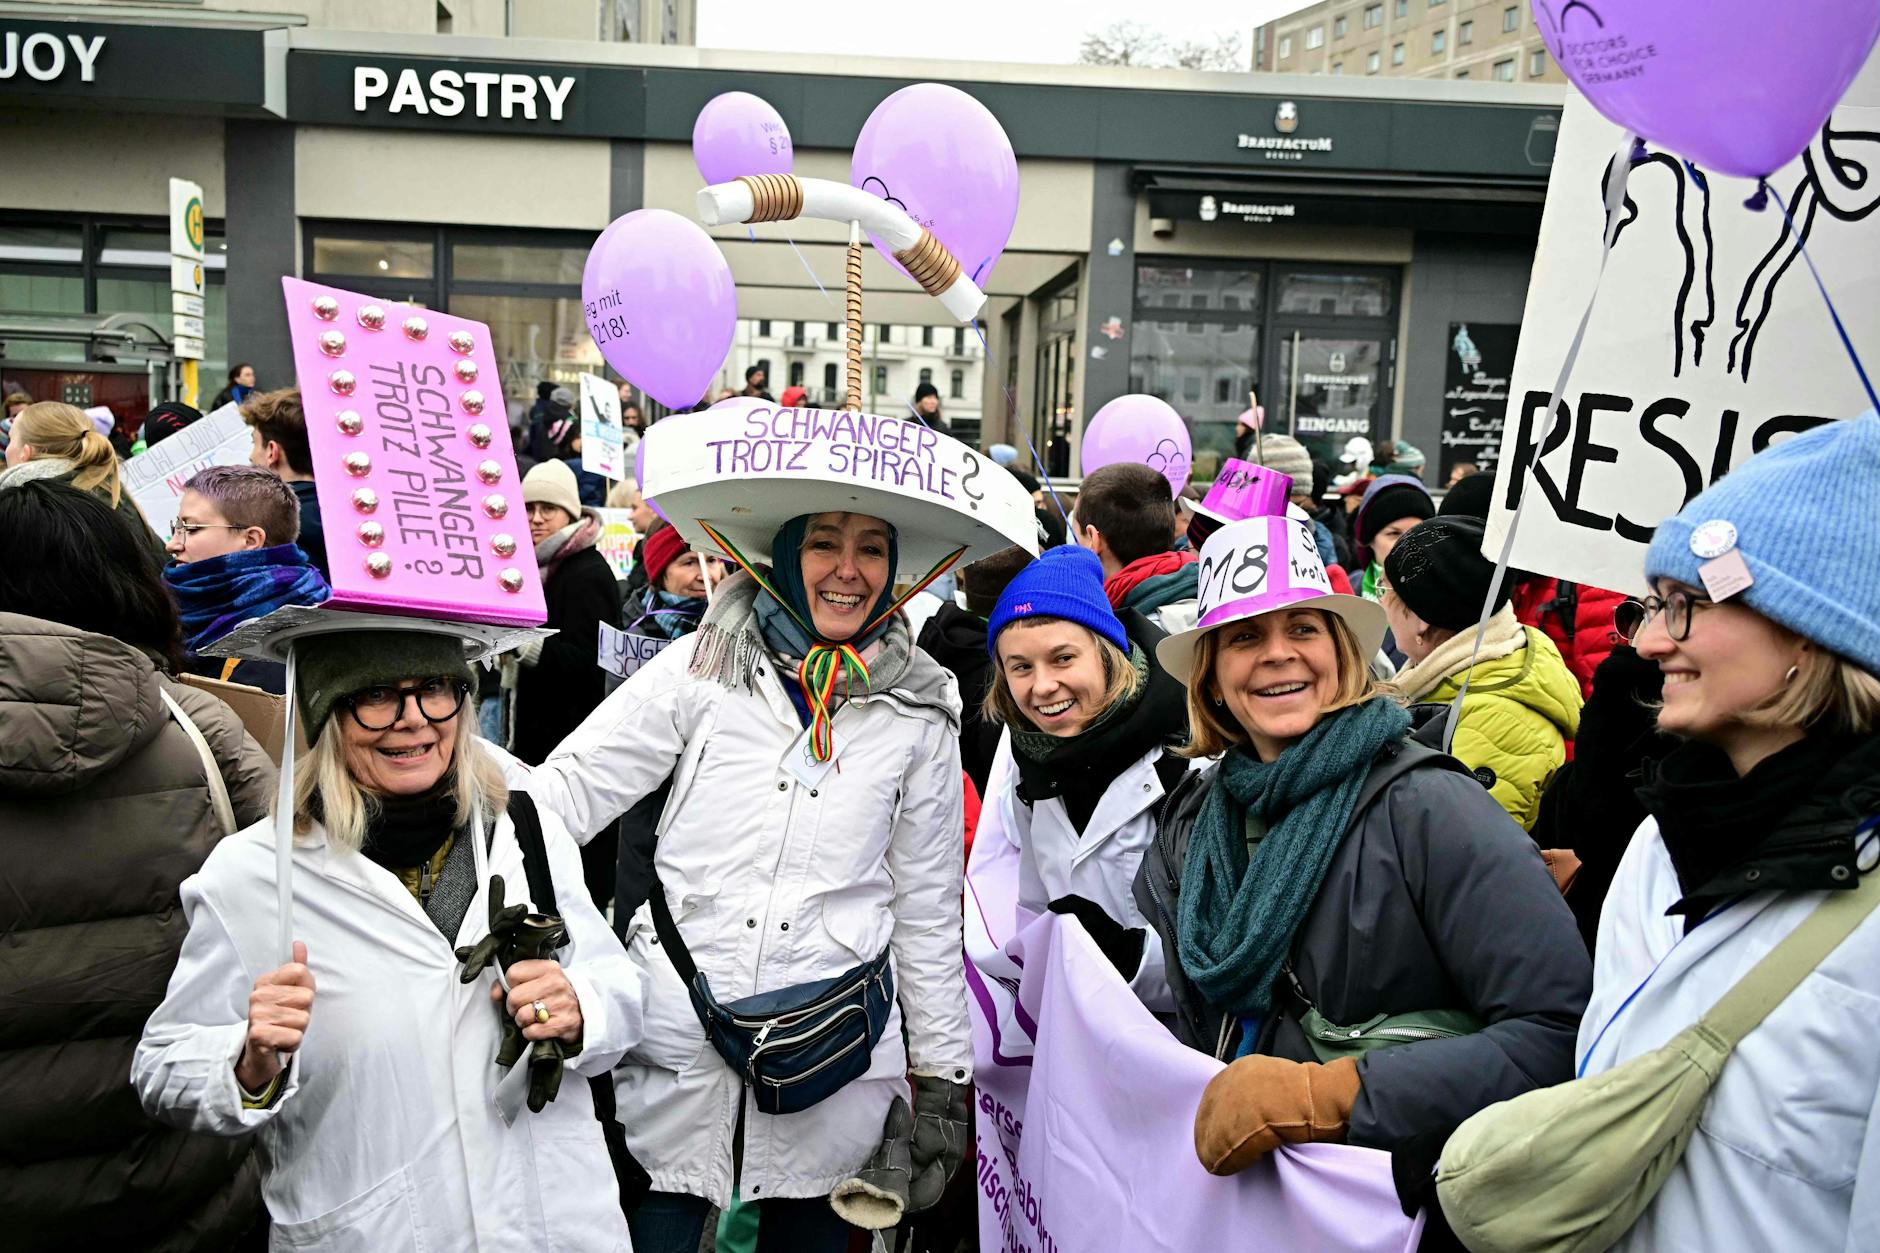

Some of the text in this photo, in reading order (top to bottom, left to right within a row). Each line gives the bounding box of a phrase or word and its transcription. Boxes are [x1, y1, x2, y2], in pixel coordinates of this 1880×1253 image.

[0, 32, 106, 81] JOY
[1598, 45, 1657, 68] CHOICE
[354, 66, 576, 121] PASTRY
[599, 289, 622, 311] mit
[369, 361, 421, 459] TROTZ
[1298, 416, 1370, 434] EINGANG
[175, 416, 226, 461] BIN
[706, 439, 812, 474] TROTZ
[744, 407, 938, 463] SCHWANGER
[411, 363, 485, 580] SCHWANGER
